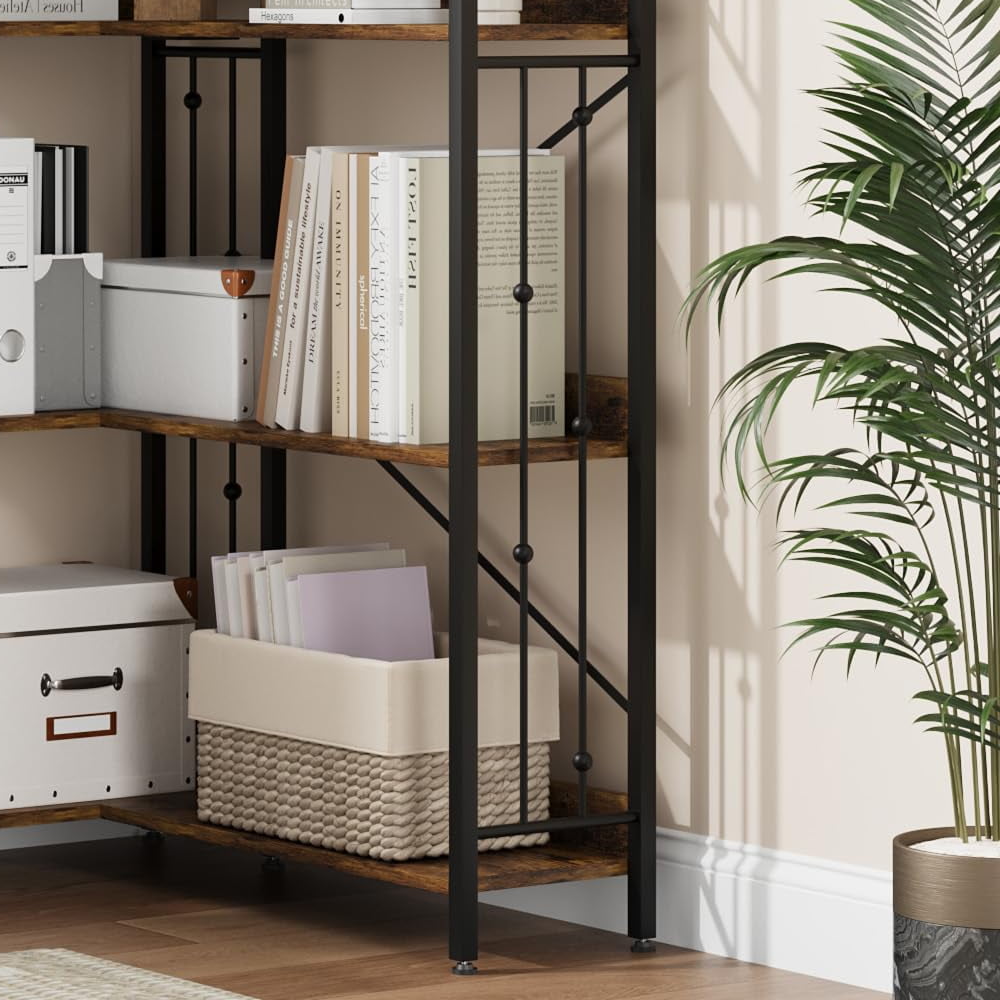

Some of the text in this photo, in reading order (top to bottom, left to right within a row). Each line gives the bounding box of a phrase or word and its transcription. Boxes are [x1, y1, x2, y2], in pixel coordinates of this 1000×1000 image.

[260, 10, 294, 23] Hexagons
[301, 182, 312, 228] lifestyle
[336, 190, 342, 210] ON
[283, 218, 294, 260] GUIDE
[279, 262, 288, 301] GOOD
[294, 232, 306, 299] sustainable
[278, 304, 284, 314] A
[292, 302, 298, 310] a
[308, 314, 318, 362] DREAM
[316, 222, 325, 268] AWAKE
[360, 274, 368, 330] spherical
[272, 330, 282, 358] THIS
